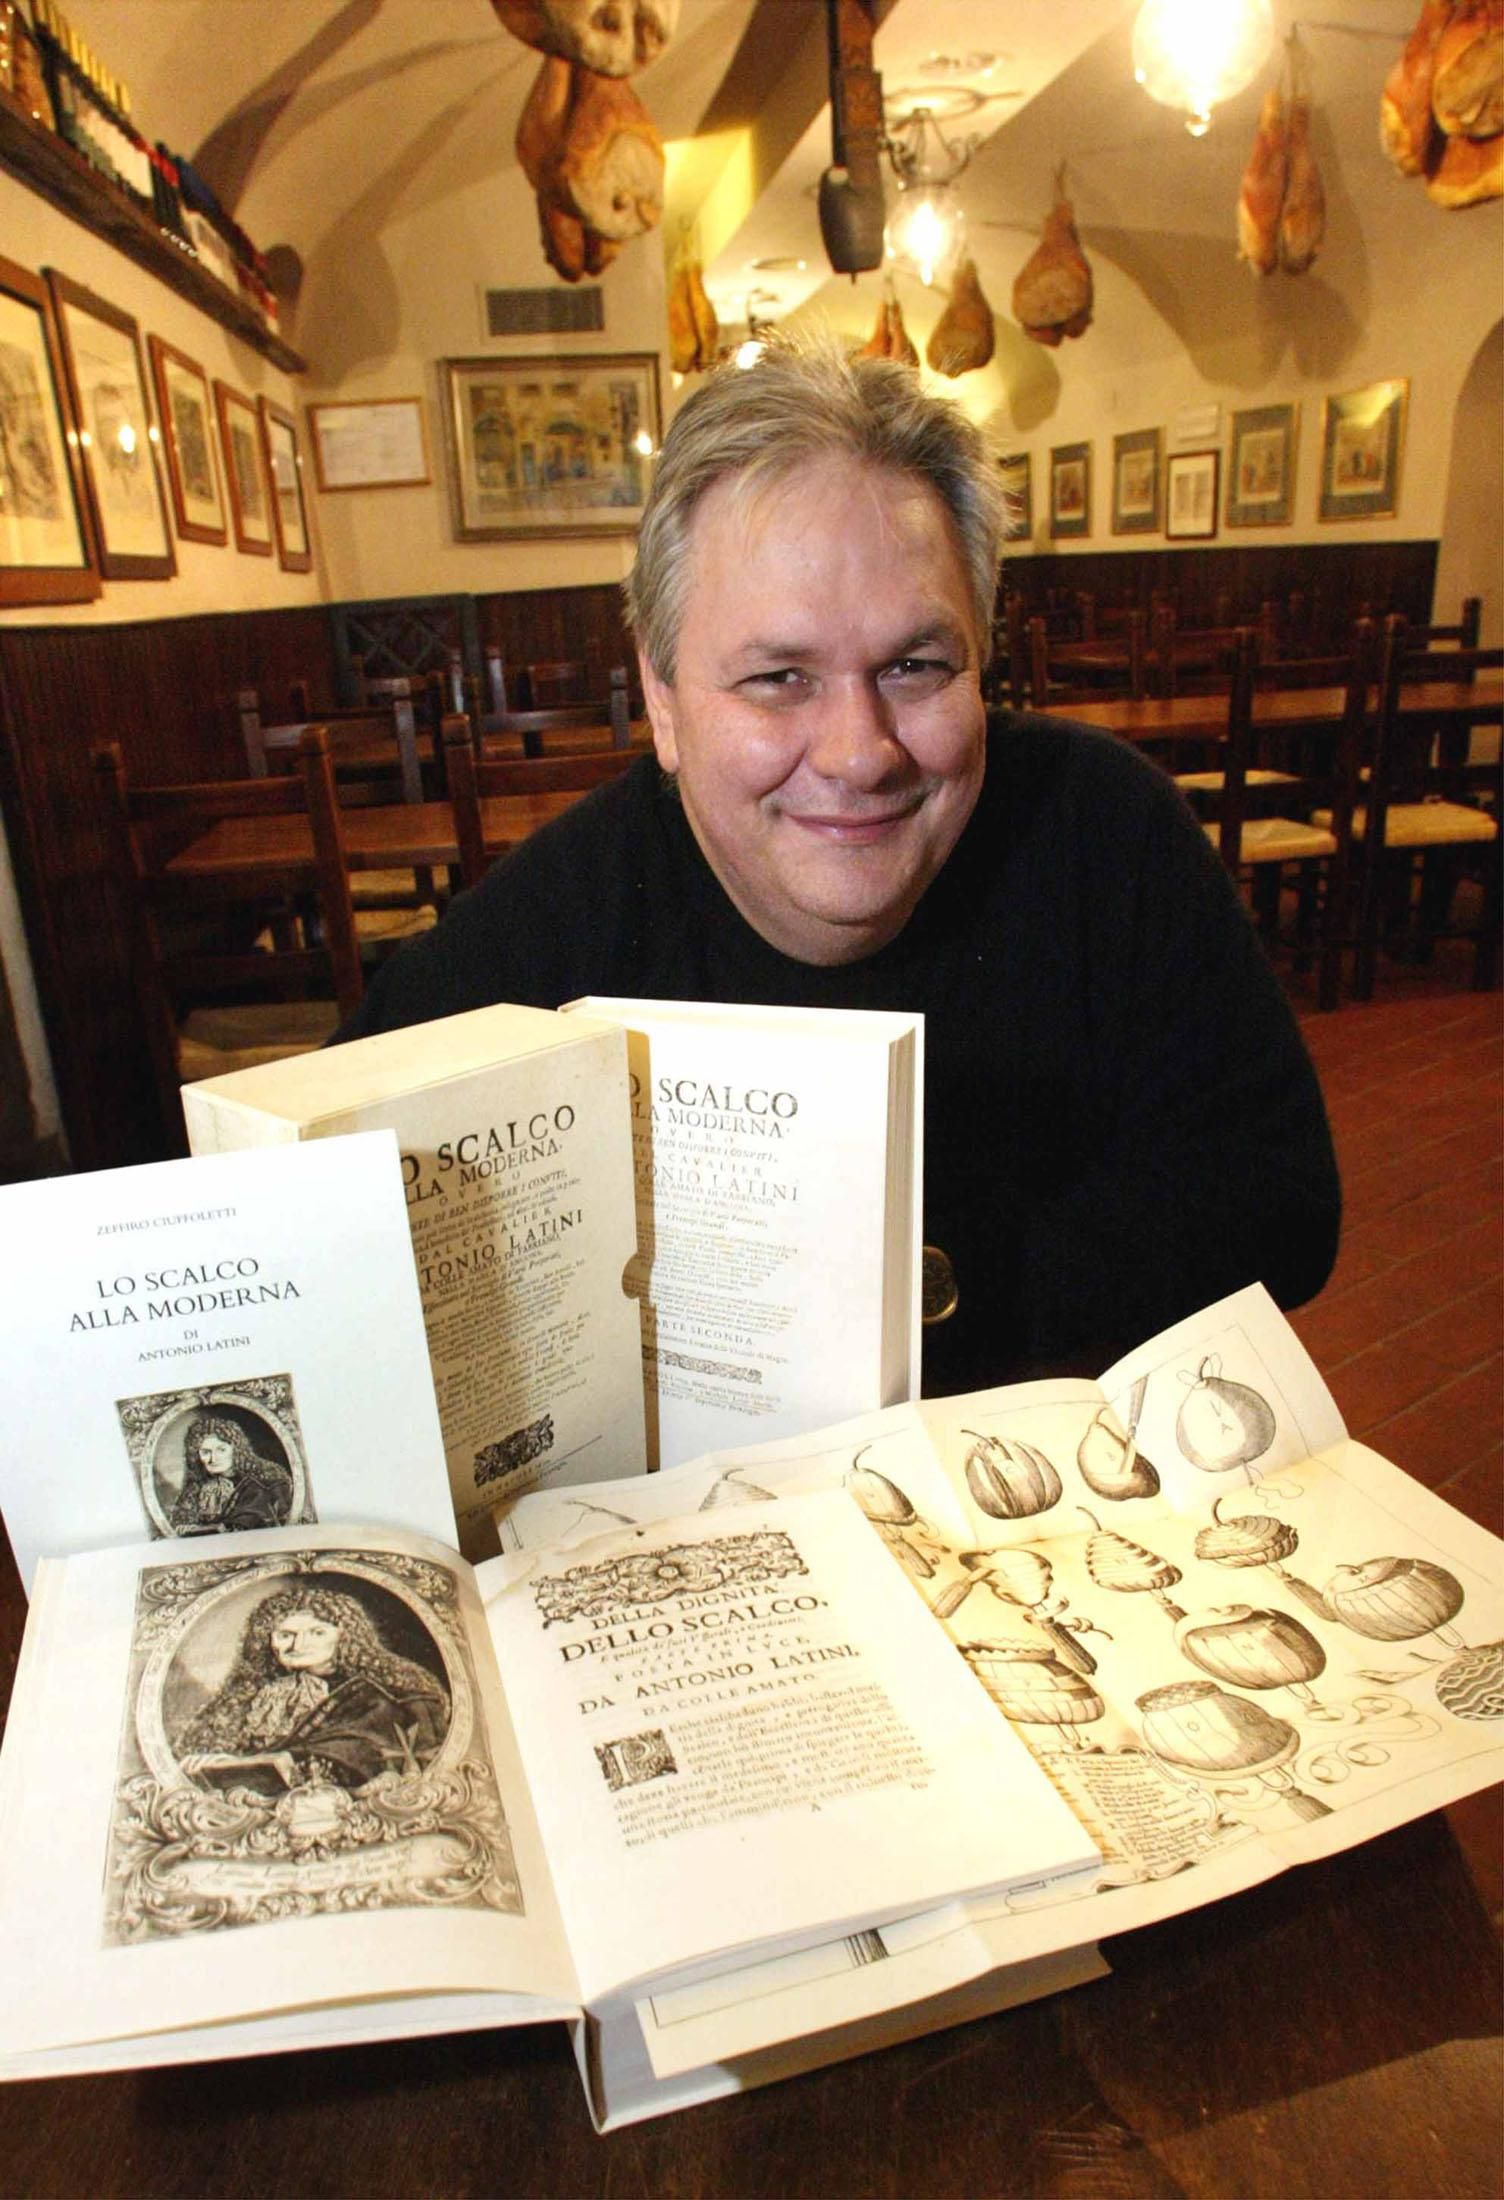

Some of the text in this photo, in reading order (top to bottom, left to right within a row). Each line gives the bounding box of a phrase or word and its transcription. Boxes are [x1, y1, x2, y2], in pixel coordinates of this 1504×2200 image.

[659, 1078, 799, 1119] SCALCO
[438, 1105, 576, 1172] SCALCO
[713, 1174, 798, 1202] LATINI
[421, 1243, 496, 1285] TONIO
[509, 1208, 584, 1250] LATINI
[97, 1256, 260, 1299] LO SCALCO
[69, 1280, 302, 1332] ALLA MODERNA
[138, 1336, 252, 1363] ANTONIO LATINI
[184, 1329, 199, 1342] DI
[592, 1606, 665, 1631] DELLA
[560, 1622, 674, 1664] DELLO
[578, 1694, 616, 1716] DA
[636, 1662, 755, 1699] ANTONIO
